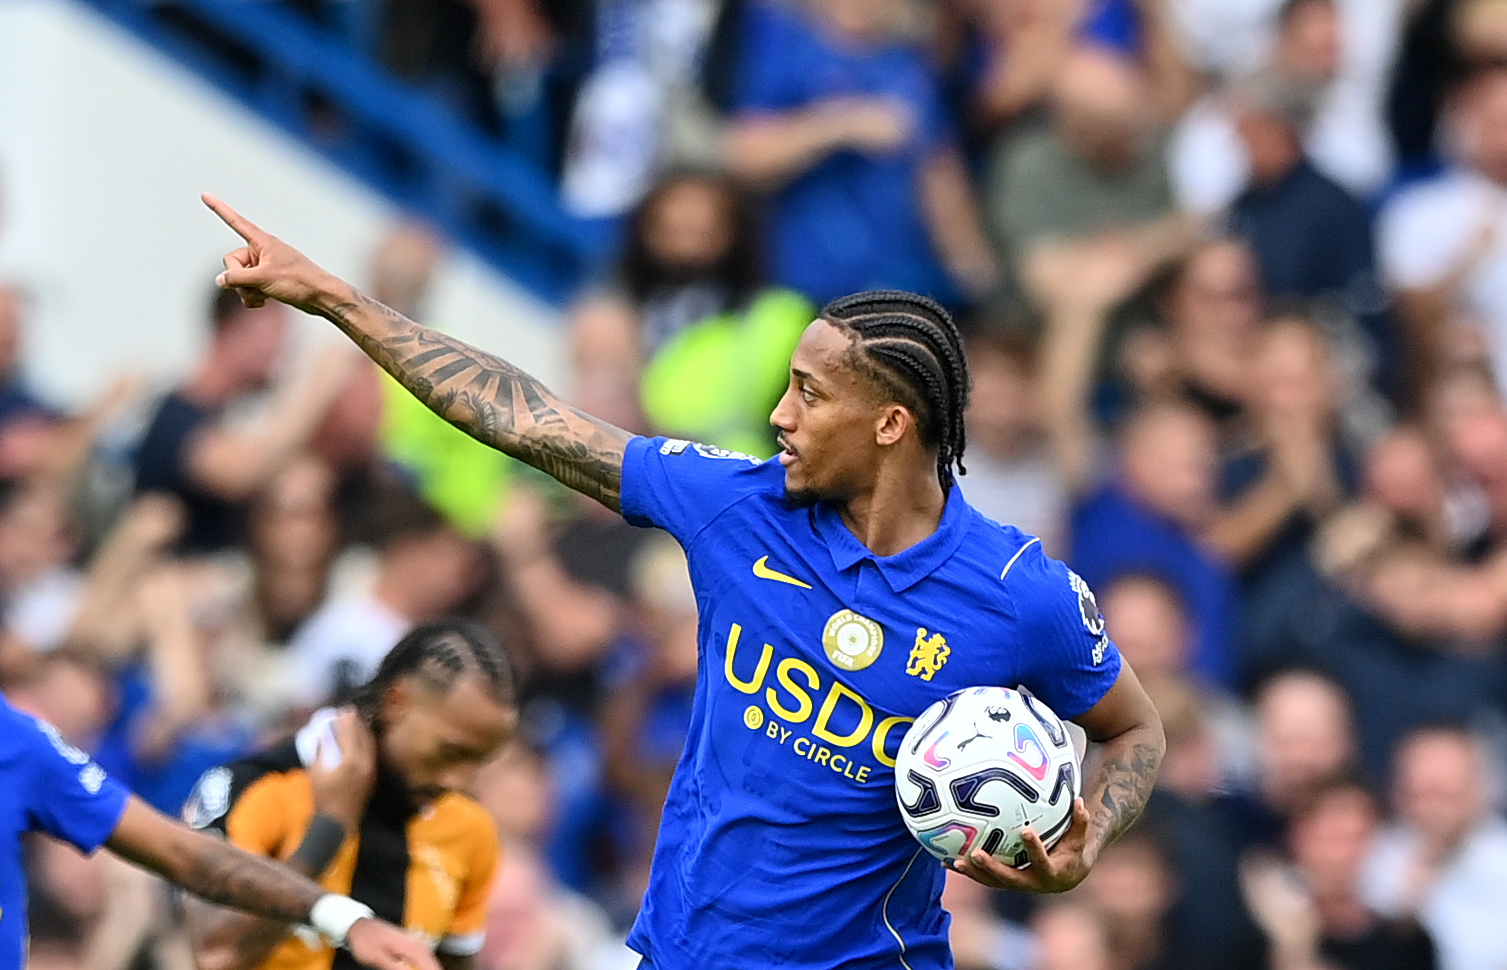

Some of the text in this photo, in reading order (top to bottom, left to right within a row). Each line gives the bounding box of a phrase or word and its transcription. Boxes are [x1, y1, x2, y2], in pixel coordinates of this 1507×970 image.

[832, 649, 853, 667] FIFA
[765, 720, 872, 783] BY CIRCLE
